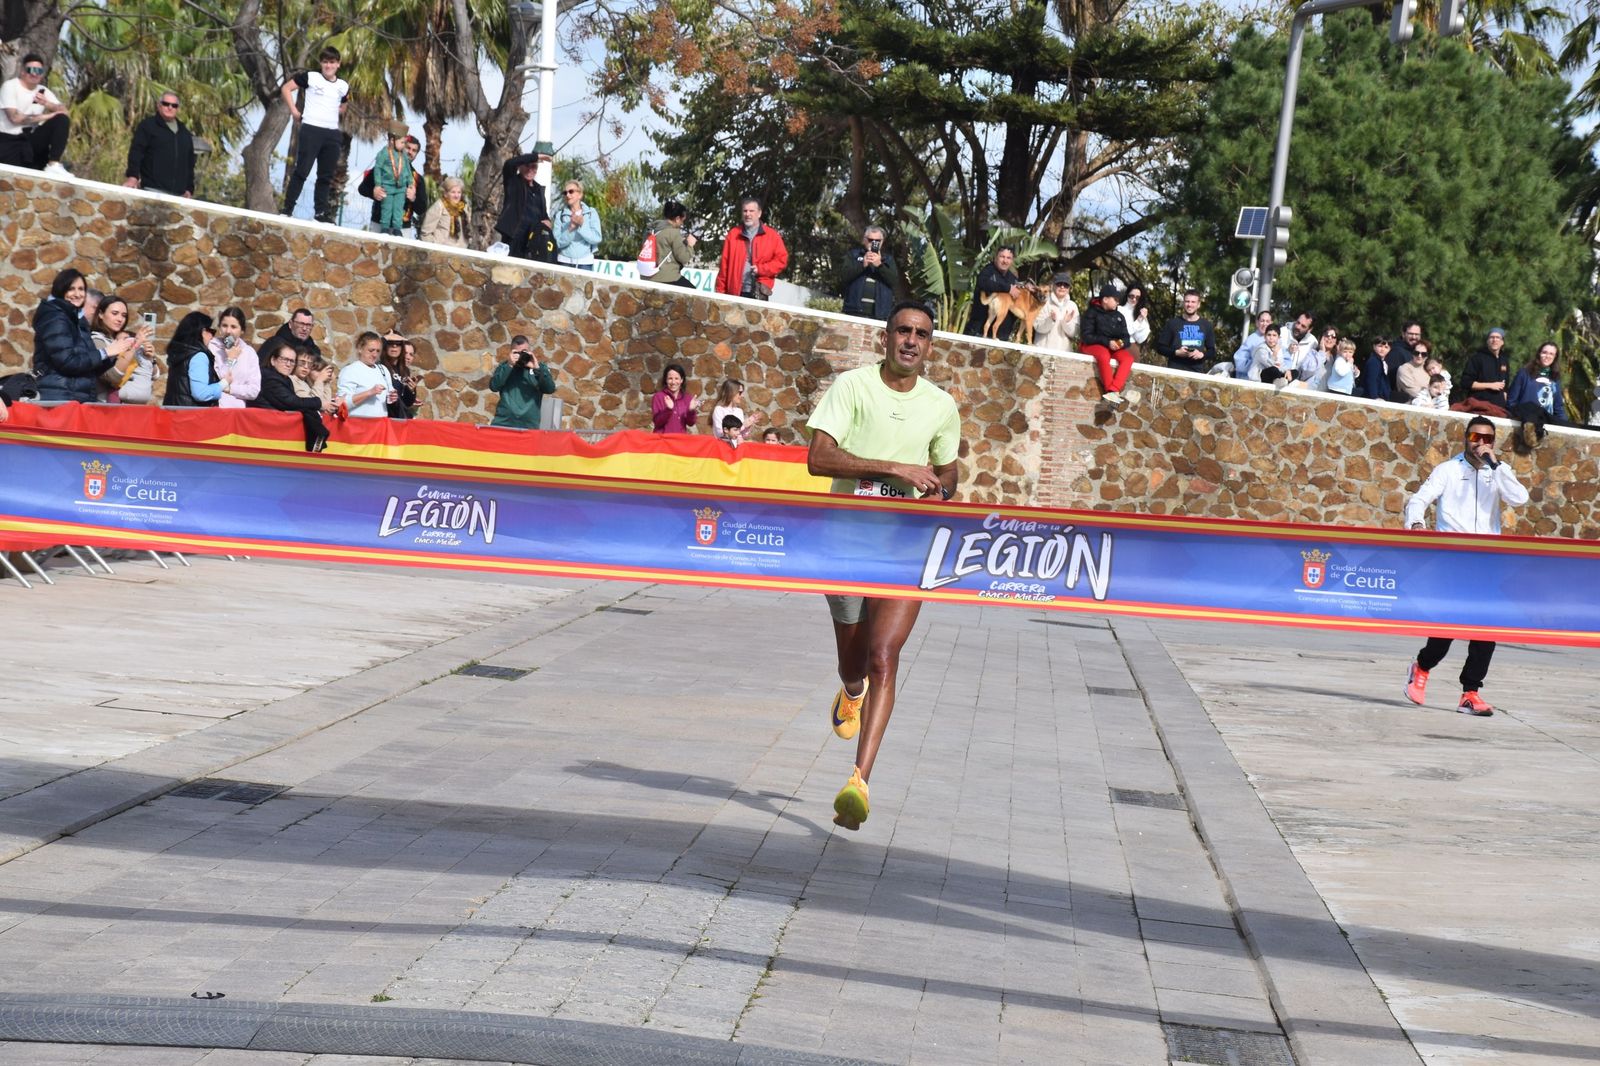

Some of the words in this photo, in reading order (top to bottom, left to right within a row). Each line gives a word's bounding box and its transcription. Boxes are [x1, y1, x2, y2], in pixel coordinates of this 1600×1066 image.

[112, 475, 138, 484] Ciudad
[125, 484, 177, 502] Ceuta
[417, 485, 450, 499] Cuna
[379, 495, 497, 544] LEGIÓN
[722, 521, 747, 529] Ciudad
[983, 512, 1037, 531] Cuna
[735, 529, 784, 546] Ceuta
[920, 526, 1112, 600] LEGIÓN
[1331, 564, 1357, 572] Ciudad
[1359, 566, 1396, 575] Autónoma
[1344, 572, 1396, 590] Ceuta
